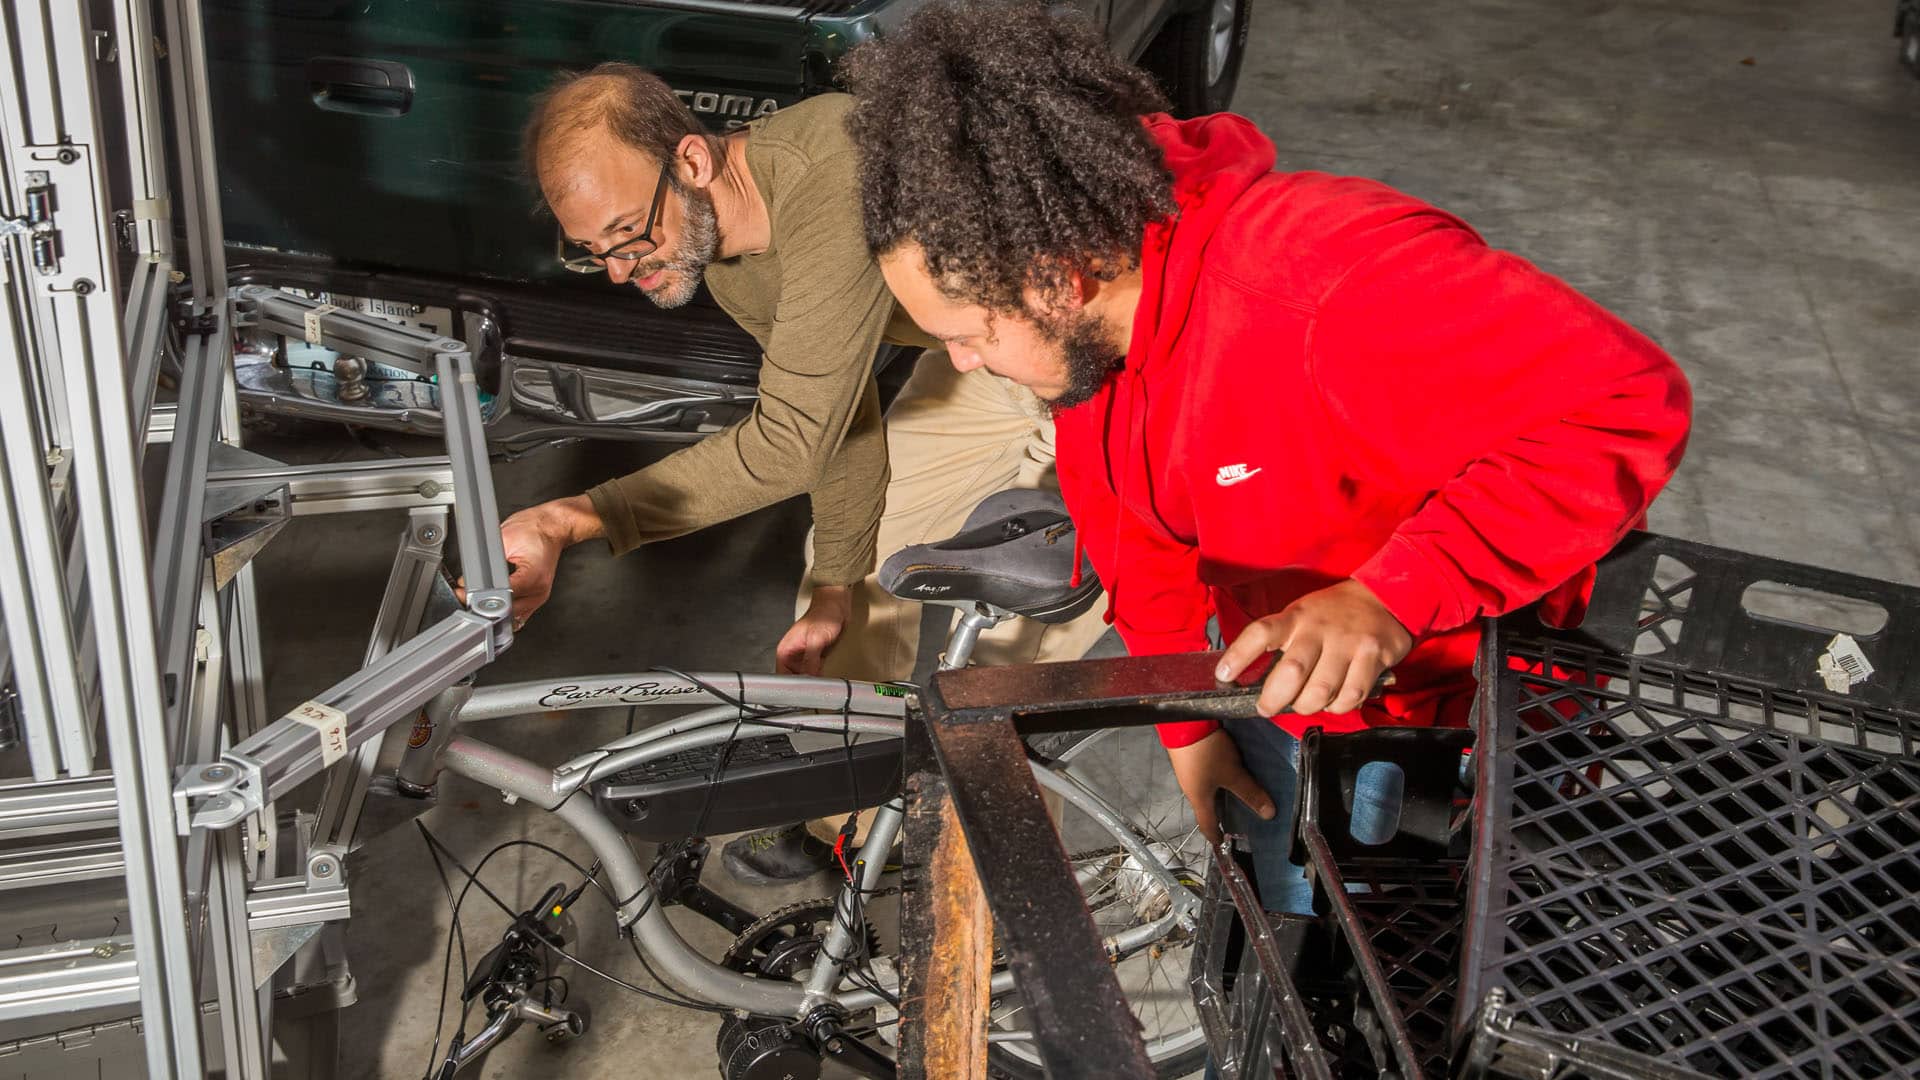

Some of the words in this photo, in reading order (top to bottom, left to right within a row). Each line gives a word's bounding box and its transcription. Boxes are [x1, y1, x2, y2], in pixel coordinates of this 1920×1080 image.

[320, 291, 366, 312] Rhode
[369, 298, 417, 318] Island
[1218, 463, 1248, 479] NIKE
[538, 685, 623, 708] Earth
